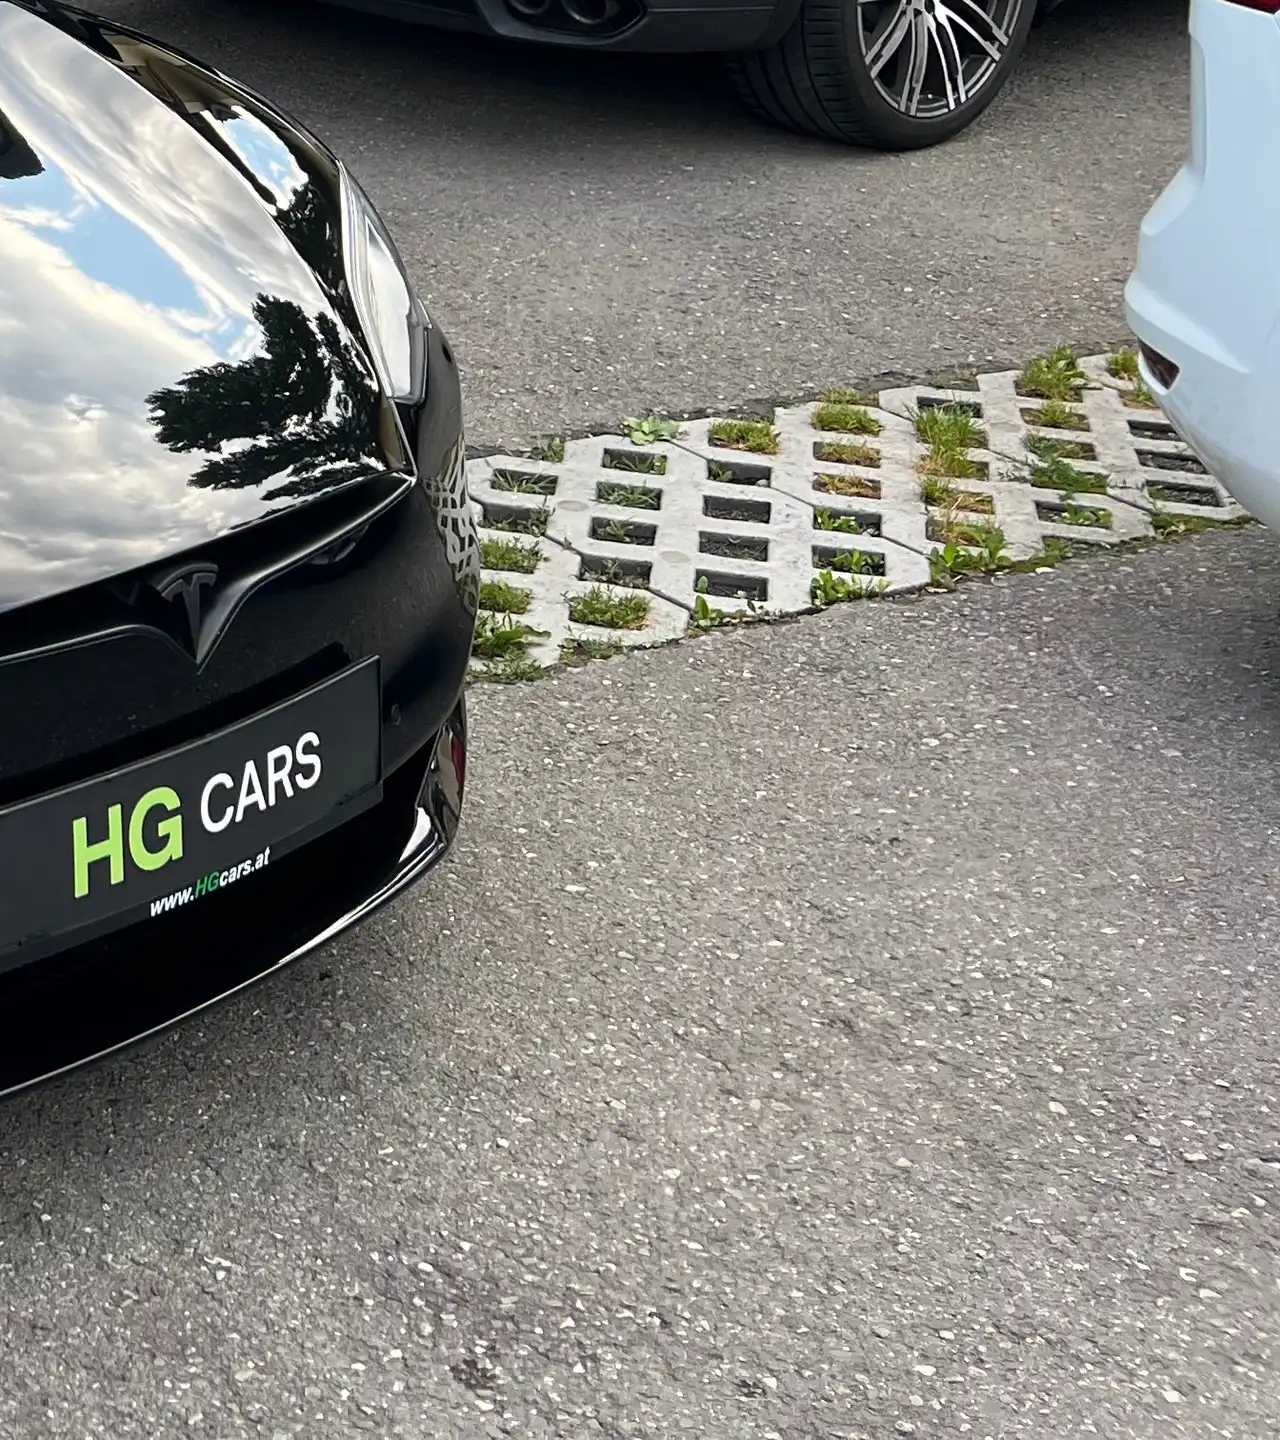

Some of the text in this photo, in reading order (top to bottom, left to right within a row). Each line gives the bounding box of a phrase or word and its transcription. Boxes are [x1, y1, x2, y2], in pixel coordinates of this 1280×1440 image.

[72, 731, 322, 899] HG CARS
[149, 845, 271, 918] www.HGcars.at
